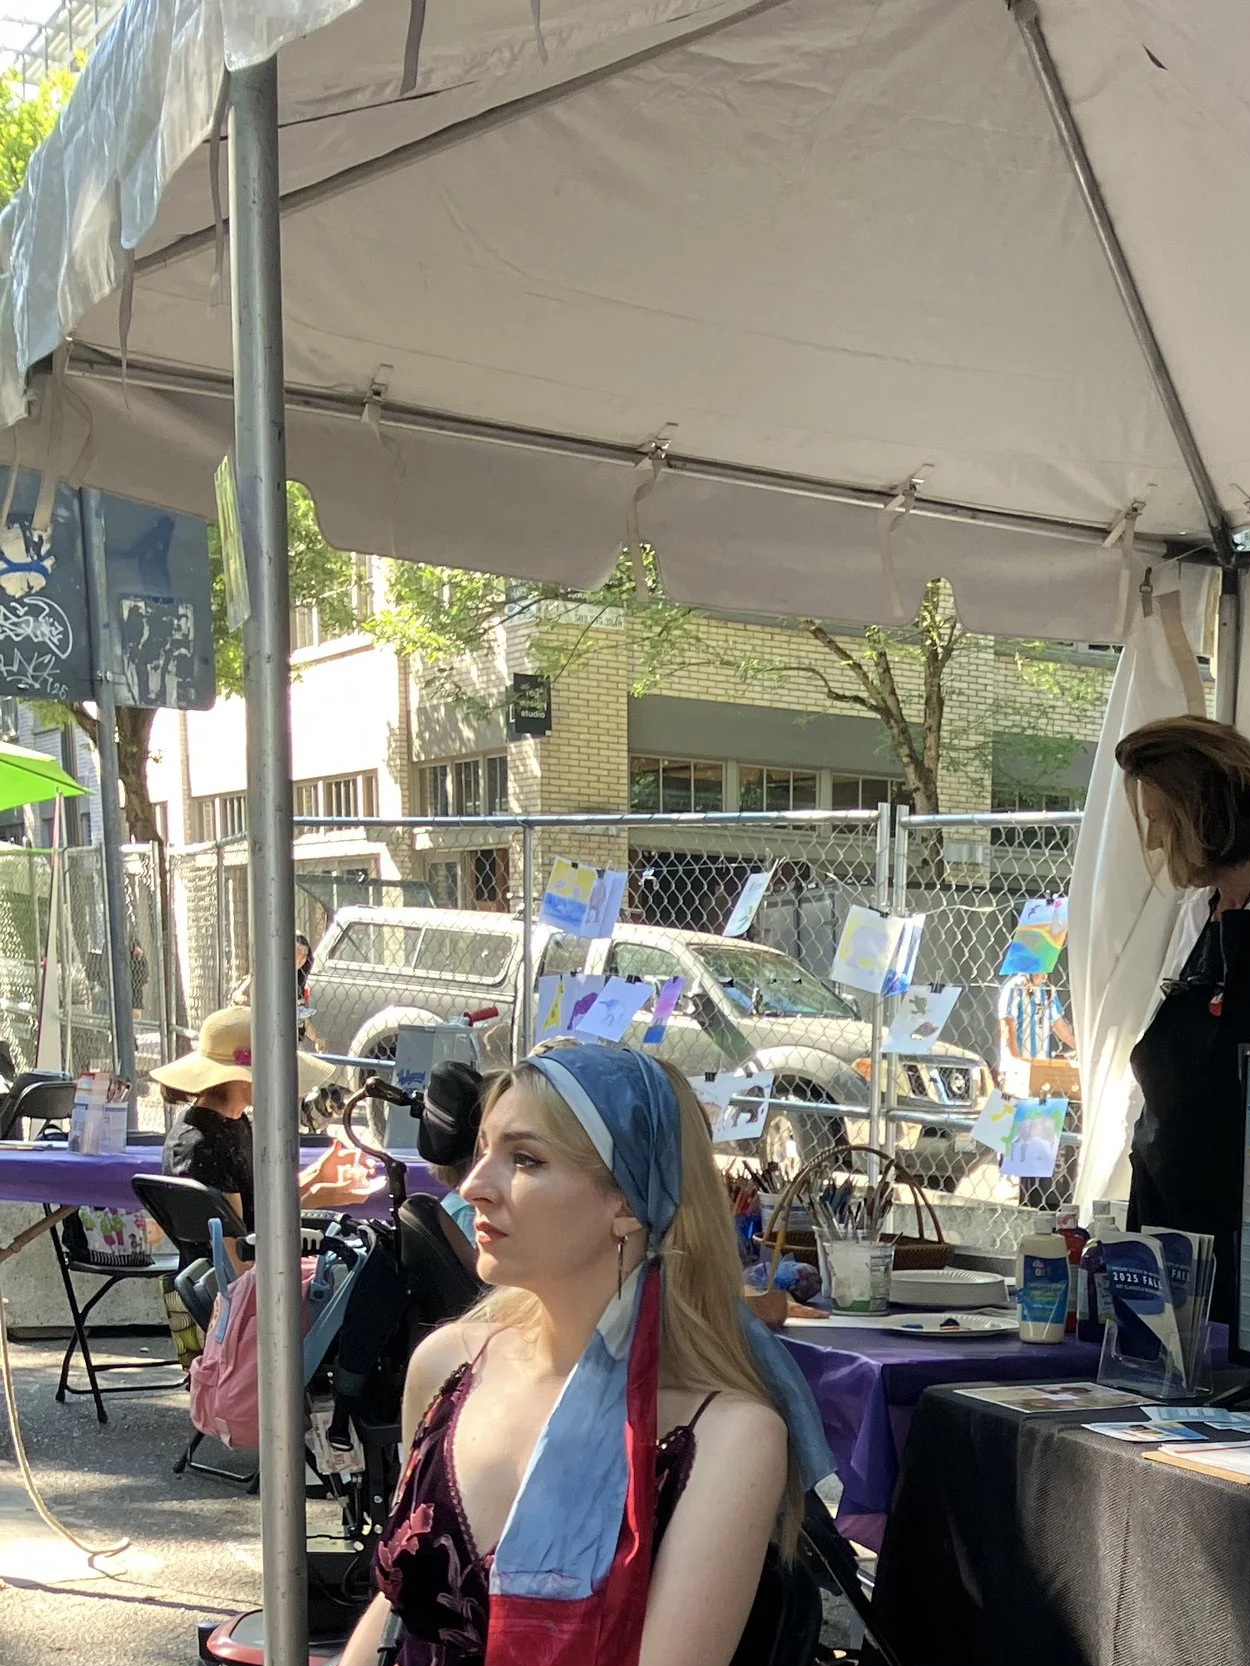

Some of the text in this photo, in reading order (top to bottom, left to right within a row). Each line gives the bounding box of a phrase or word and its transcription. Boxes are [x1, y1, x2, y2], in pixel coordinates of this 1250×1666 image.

[521, 709, 546, 719] studio
[1112, 1271, 1139, 1283] 2025
[1142, 1275, 1163, 1290] FALL
